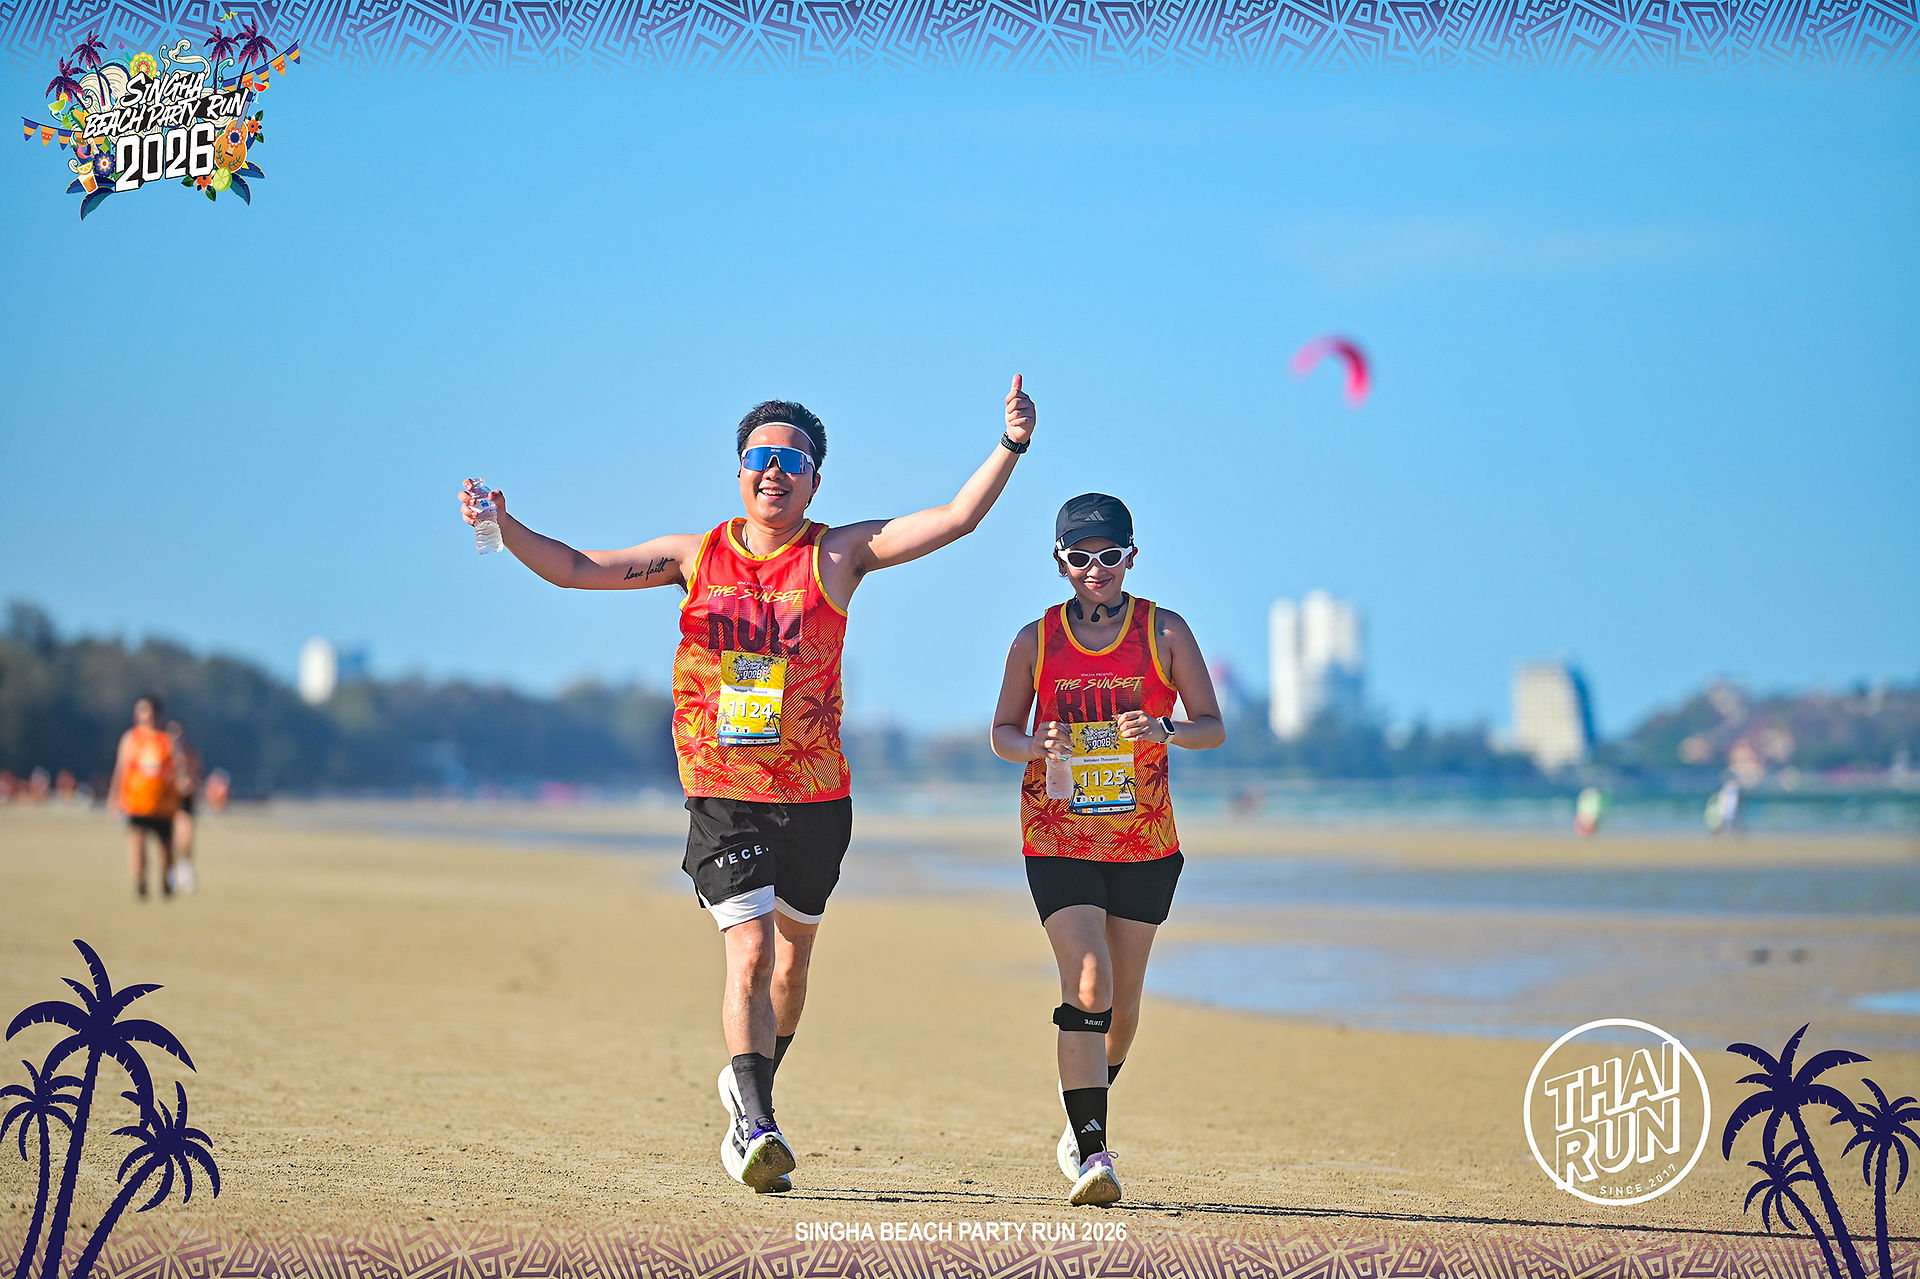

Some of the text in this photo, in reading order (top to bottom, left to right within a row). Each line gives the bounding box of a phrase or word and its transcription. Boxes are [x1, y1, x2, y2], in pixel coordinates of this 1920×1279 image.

[707, 585, 807, 605] THE SUNSET
[1055, 674, 1145, 694] THE SUNSET
[730, 701, 772, 719] 1124
[1080, 769, 1126, 787] 1125
[714, 844, 770, 869] VECE
